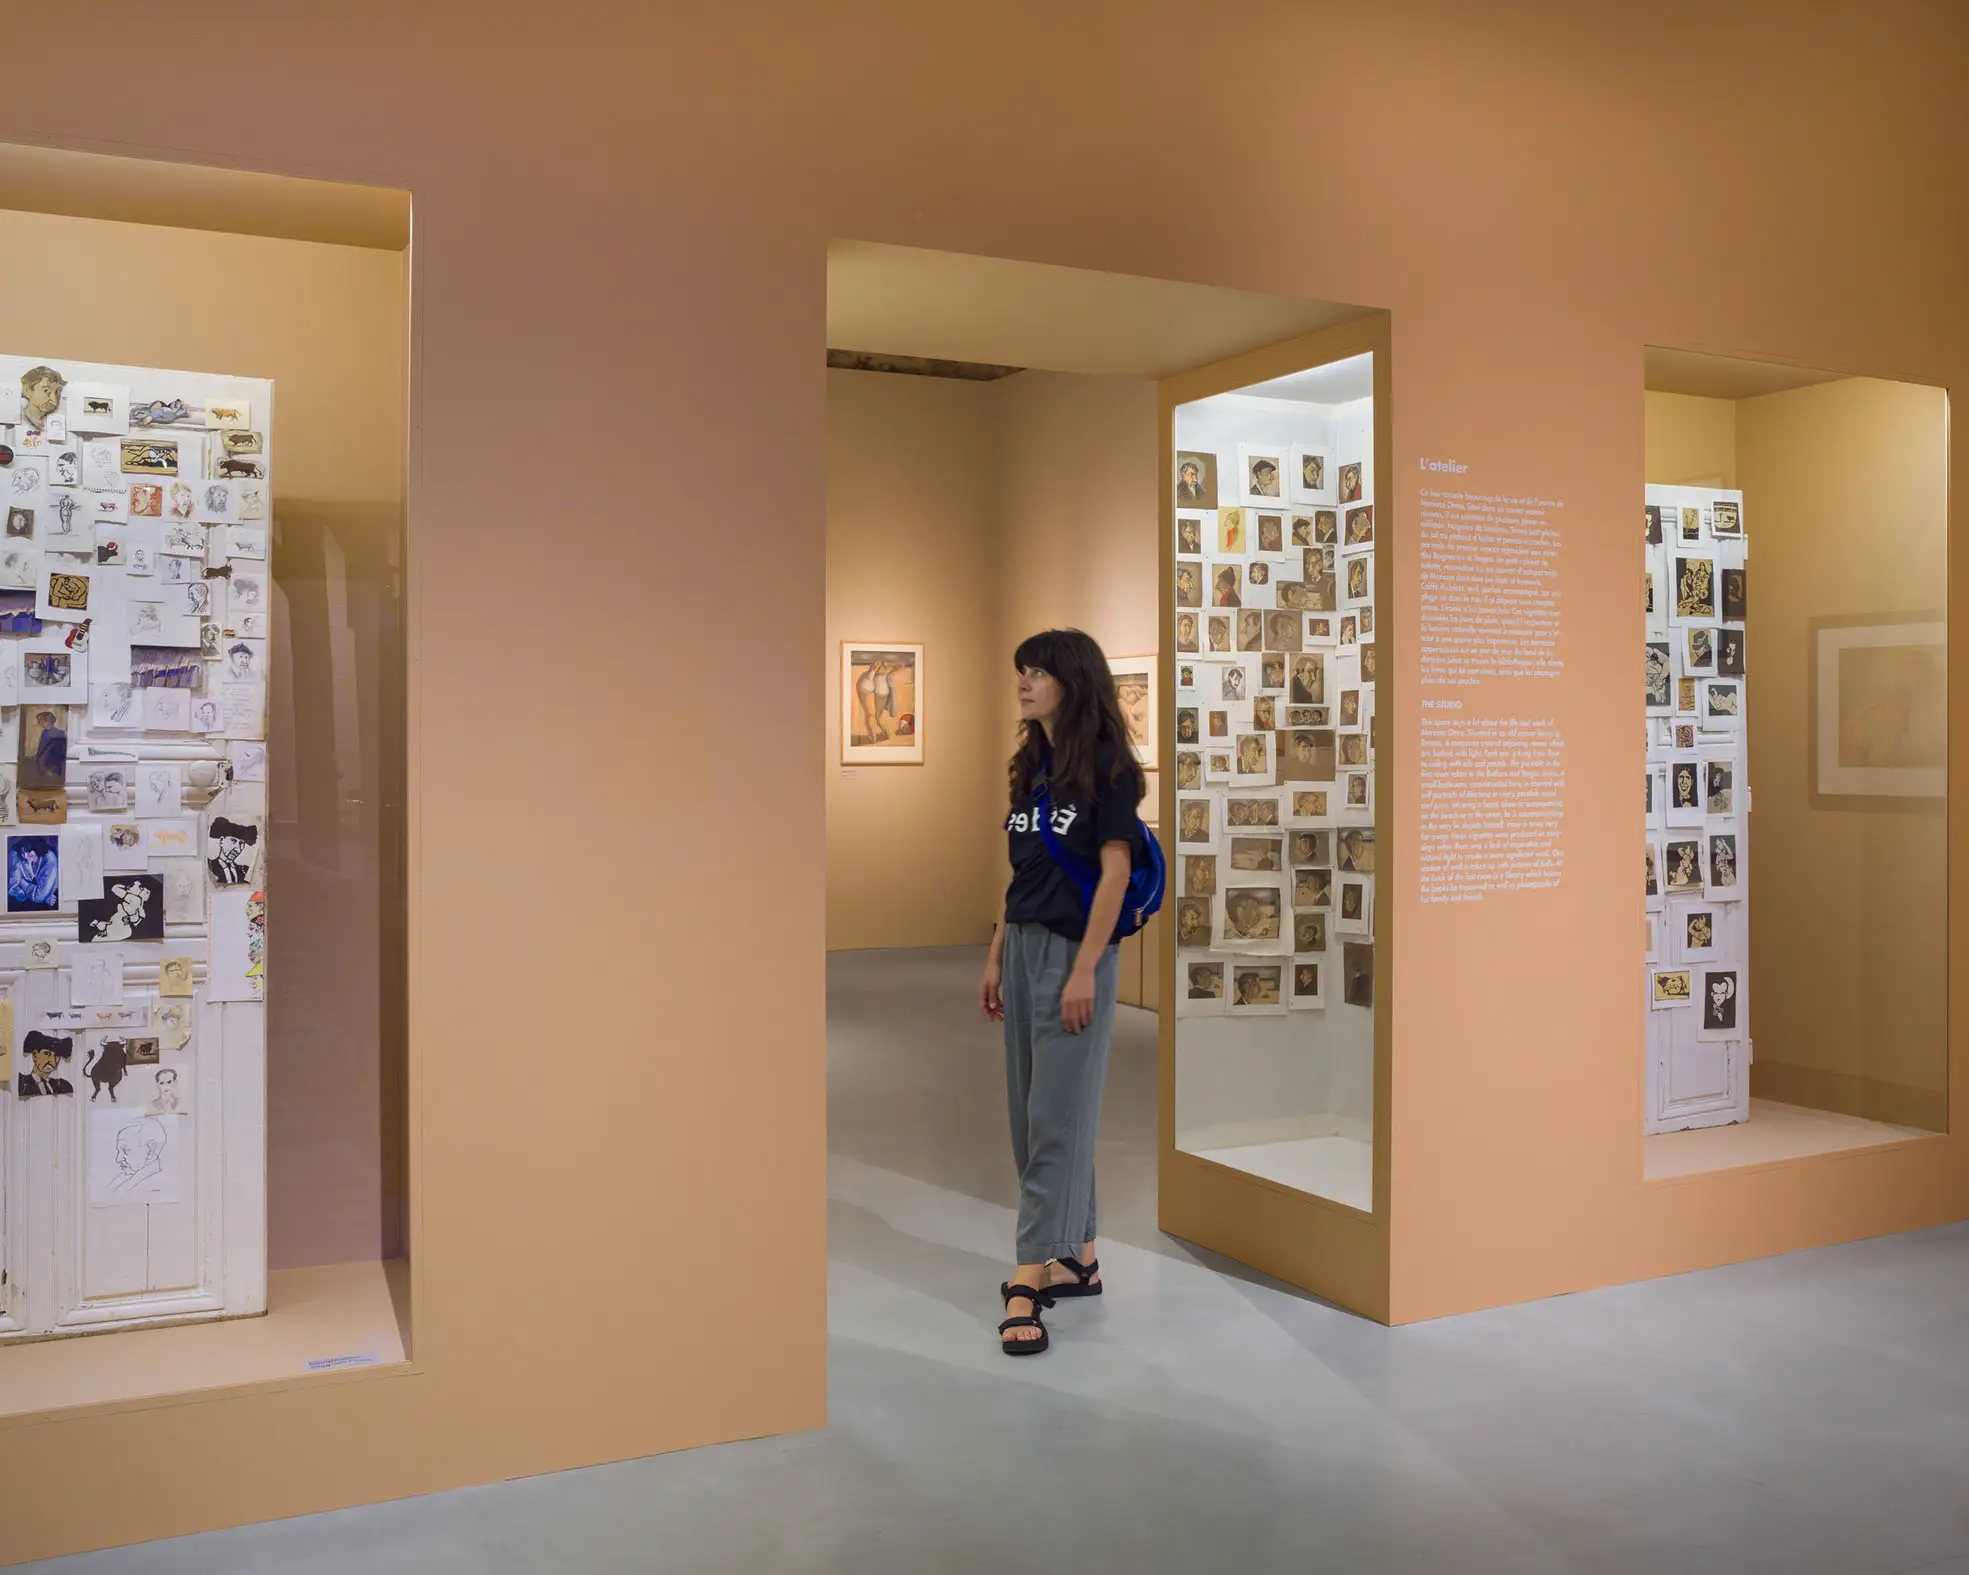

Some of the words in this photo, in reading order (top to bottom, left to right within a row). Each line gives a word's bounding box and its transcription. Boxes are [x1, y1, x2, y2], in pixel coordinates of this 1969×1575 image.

[1420, 457, 1468, 474] L'atelier
[1421, 700, 1434, 709] THE
[1435, 700, 1462, 709] STUDIO
